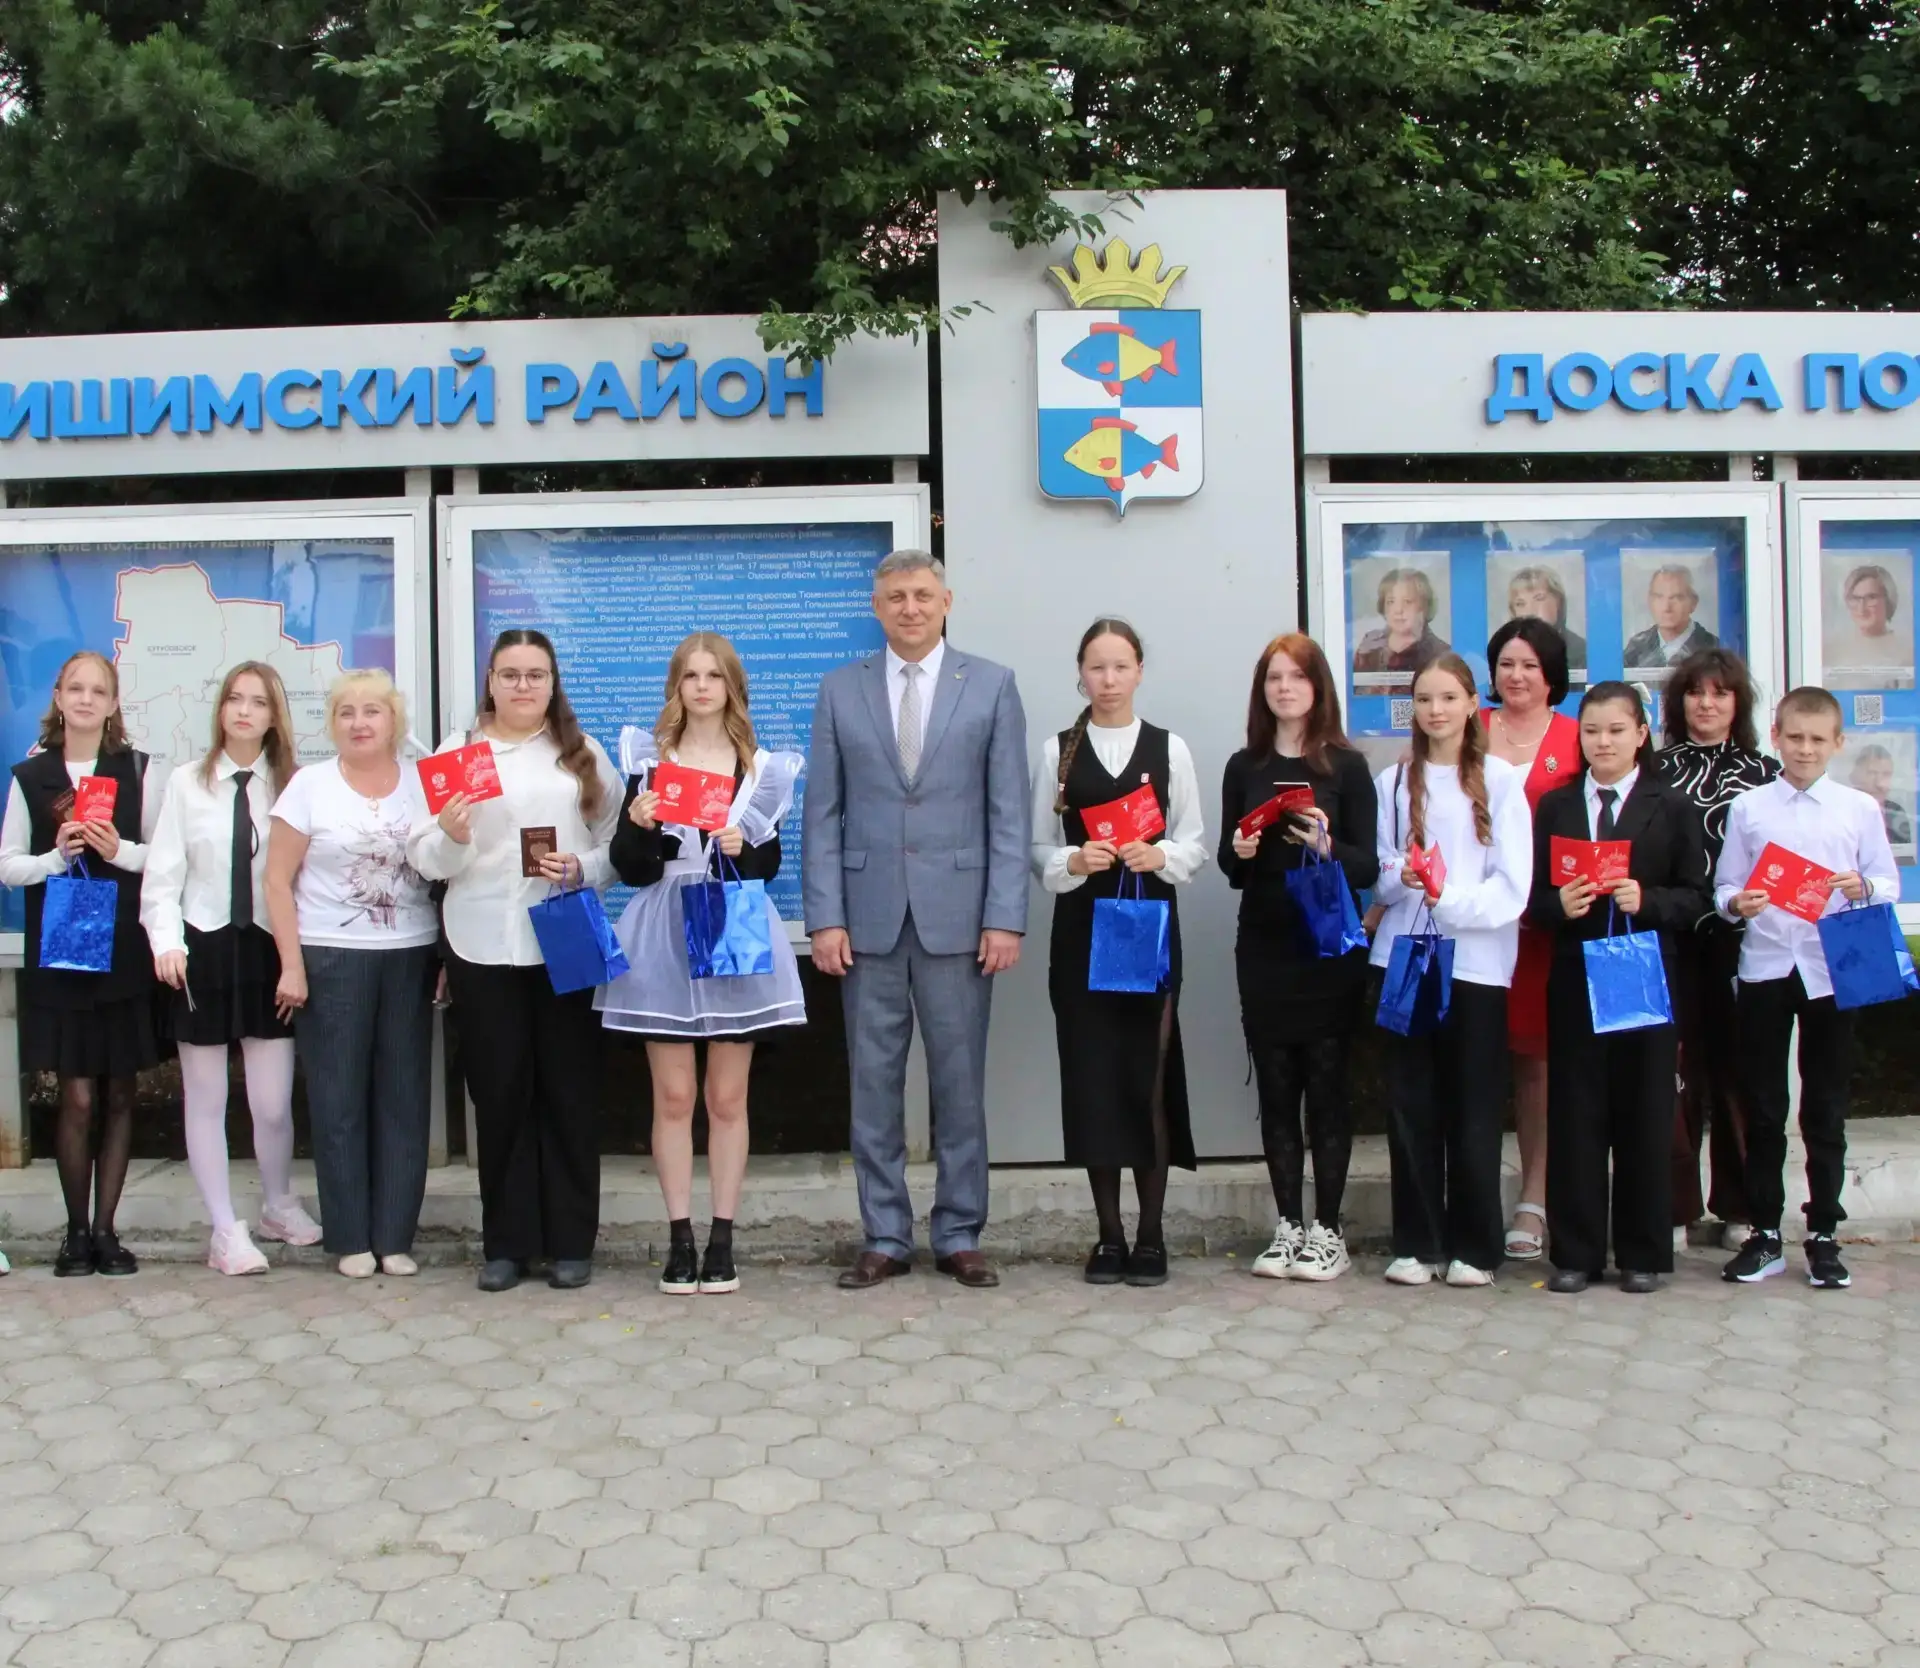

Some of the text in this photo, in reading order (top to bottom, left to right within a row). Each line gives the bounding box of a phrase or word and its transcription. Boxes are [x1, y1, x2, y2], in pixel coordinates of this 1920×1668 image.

[0, 341, 824, 440] ИШИМСКИЙ РАЙОН
[1485, 351, 1785, 424] ДОСКА
[847, 588, 873, 598] облас
